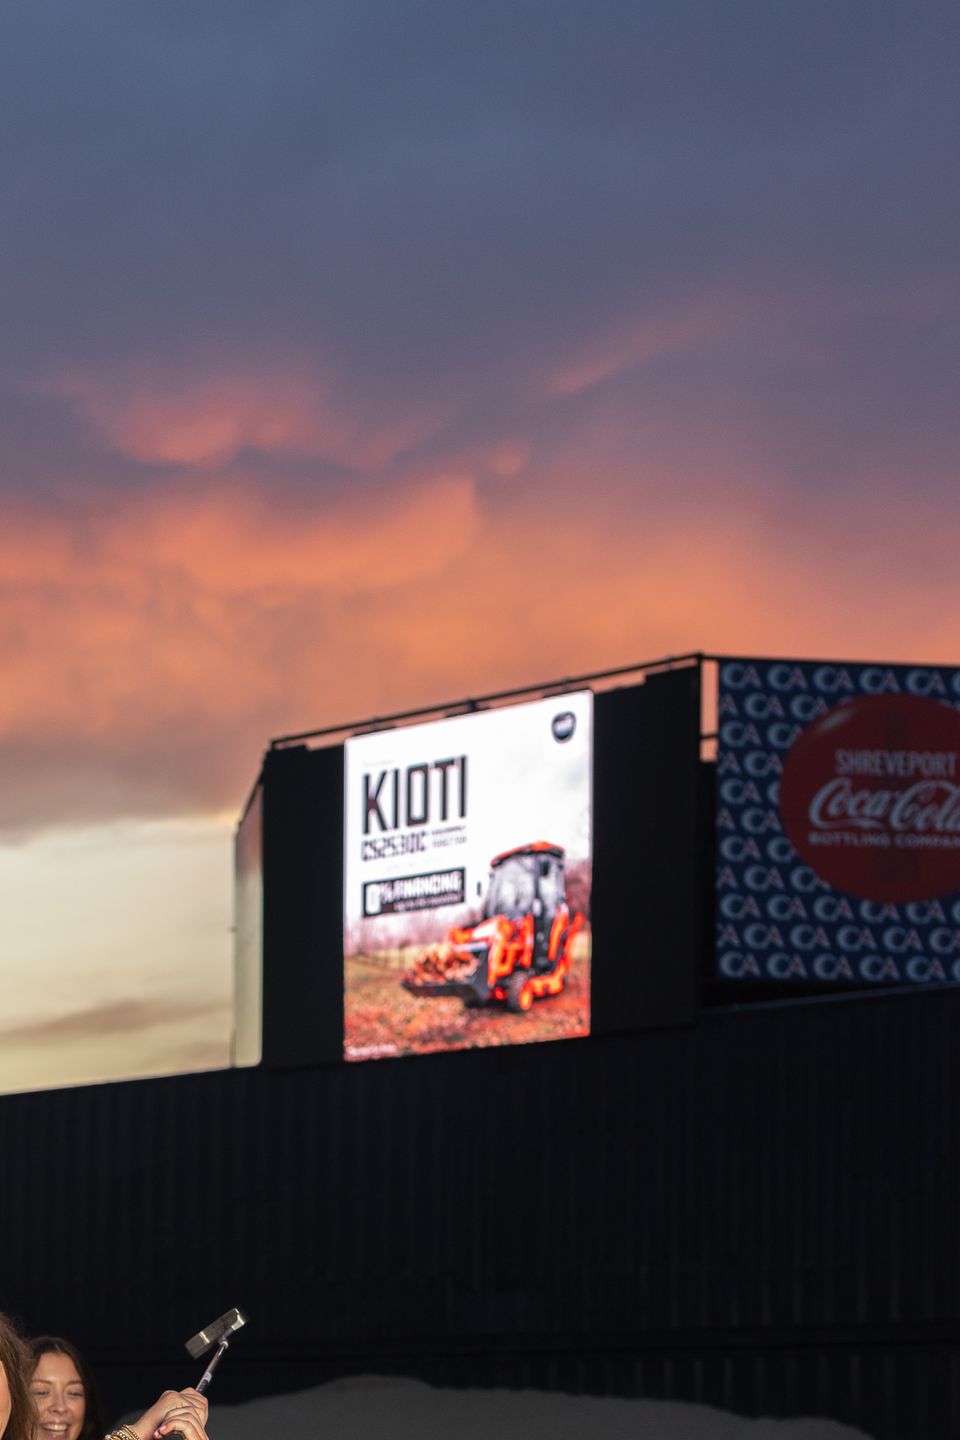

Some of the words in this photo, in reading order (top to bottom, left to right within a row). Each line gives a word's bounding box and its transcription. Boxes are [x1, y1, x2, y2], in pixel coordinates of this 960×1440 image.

[835, 749, 958, 776] SHREVEPORT
[362, 755, 468, 834] KIOTI
[808, 831, 891, 848] BOTTLING
[894, 833, 960, 849] COMPAN
